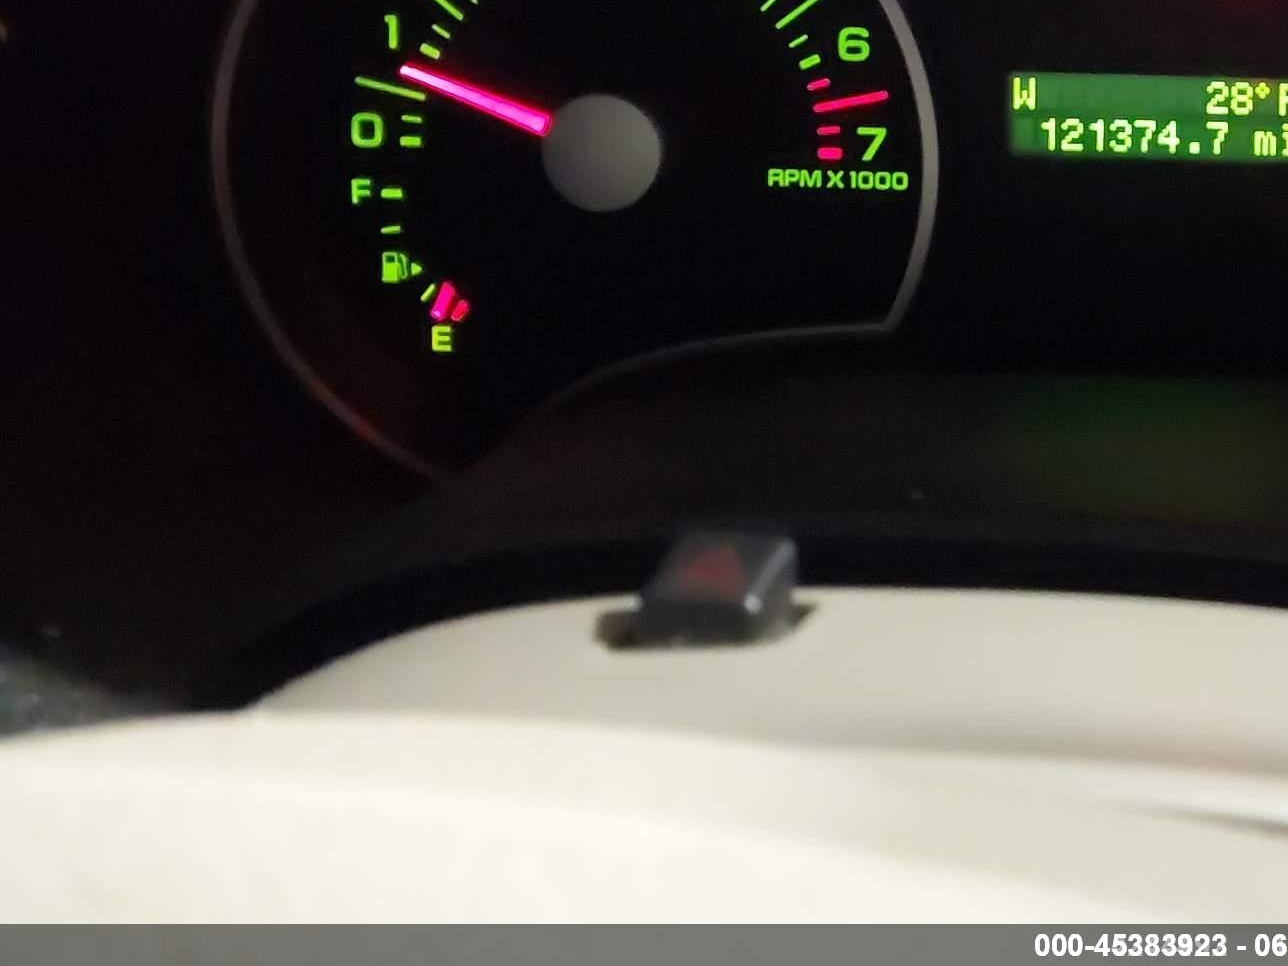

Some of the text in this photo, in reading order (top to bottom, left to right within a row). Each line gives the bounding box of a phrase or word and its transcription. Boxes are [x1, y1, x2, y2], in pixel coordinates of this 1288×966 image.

[385, 15, 397, 49] 1
[838, 27, 869, 61] 6
[1014, 78, 1035, 109] W
[351, 113, 383, 147] 0
[857, 127, 886, 161] 7
[1042, 118, 1228, 154] 121374.7
[351, 179, 370, 203] F
[768, 169, 908, 190] RPM X 1000
[432, 326, 451, 351] E
